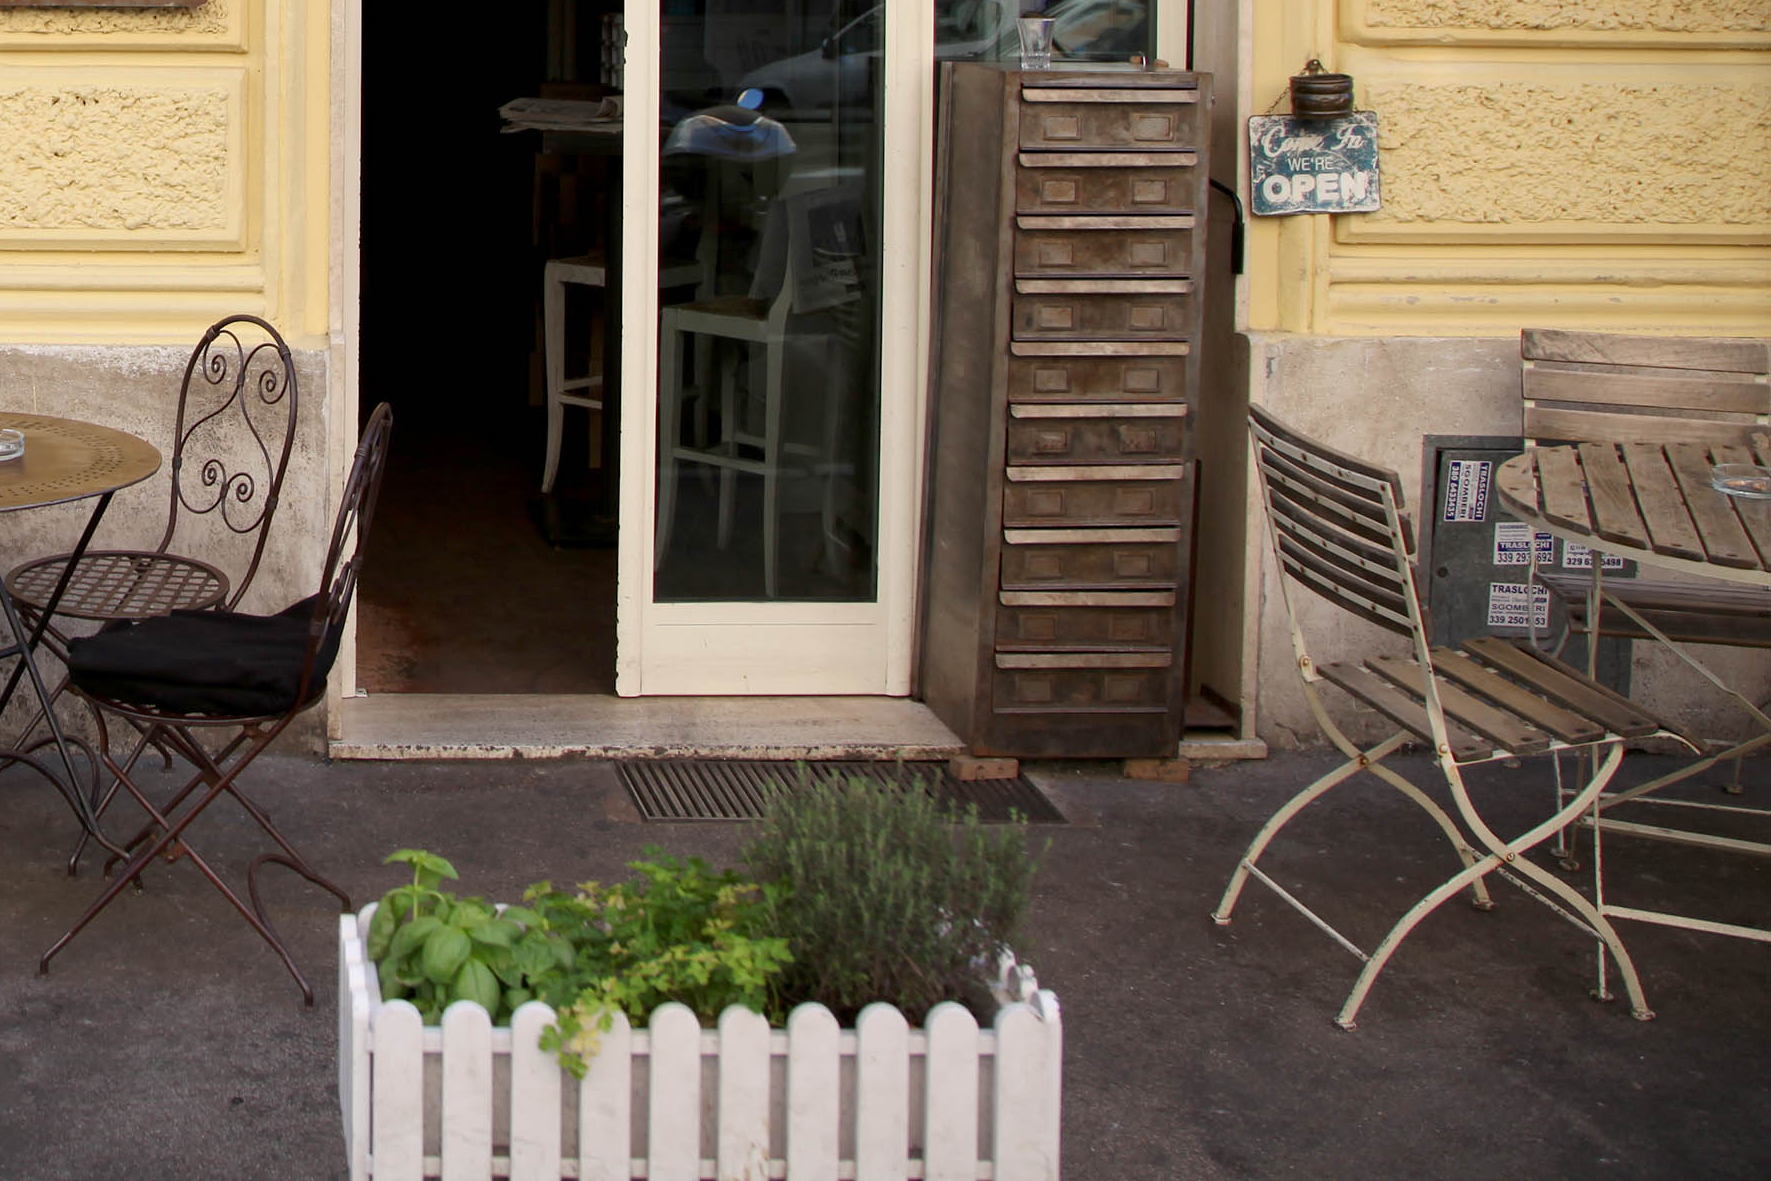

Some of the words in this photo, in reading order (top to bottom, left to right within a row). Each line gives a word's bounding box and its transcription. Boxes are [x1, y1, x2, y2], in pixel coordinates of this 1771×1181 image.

[1261, 125, 1325, 157] Come
[1331, 124, 1364, 151] In
[1287, 157, 1334, 171] WE'RE
[1263, 171, 1368, 205] OPEN
[1460, 464, 1471, 518] SGOMBERI
[1476, 465, 1488, 518] TRASLOCHI
[1498, 553, 1513, 562] 339
[1489, 615, 1505, 624] 339
[1507, 616, 1546, 626] 250153
